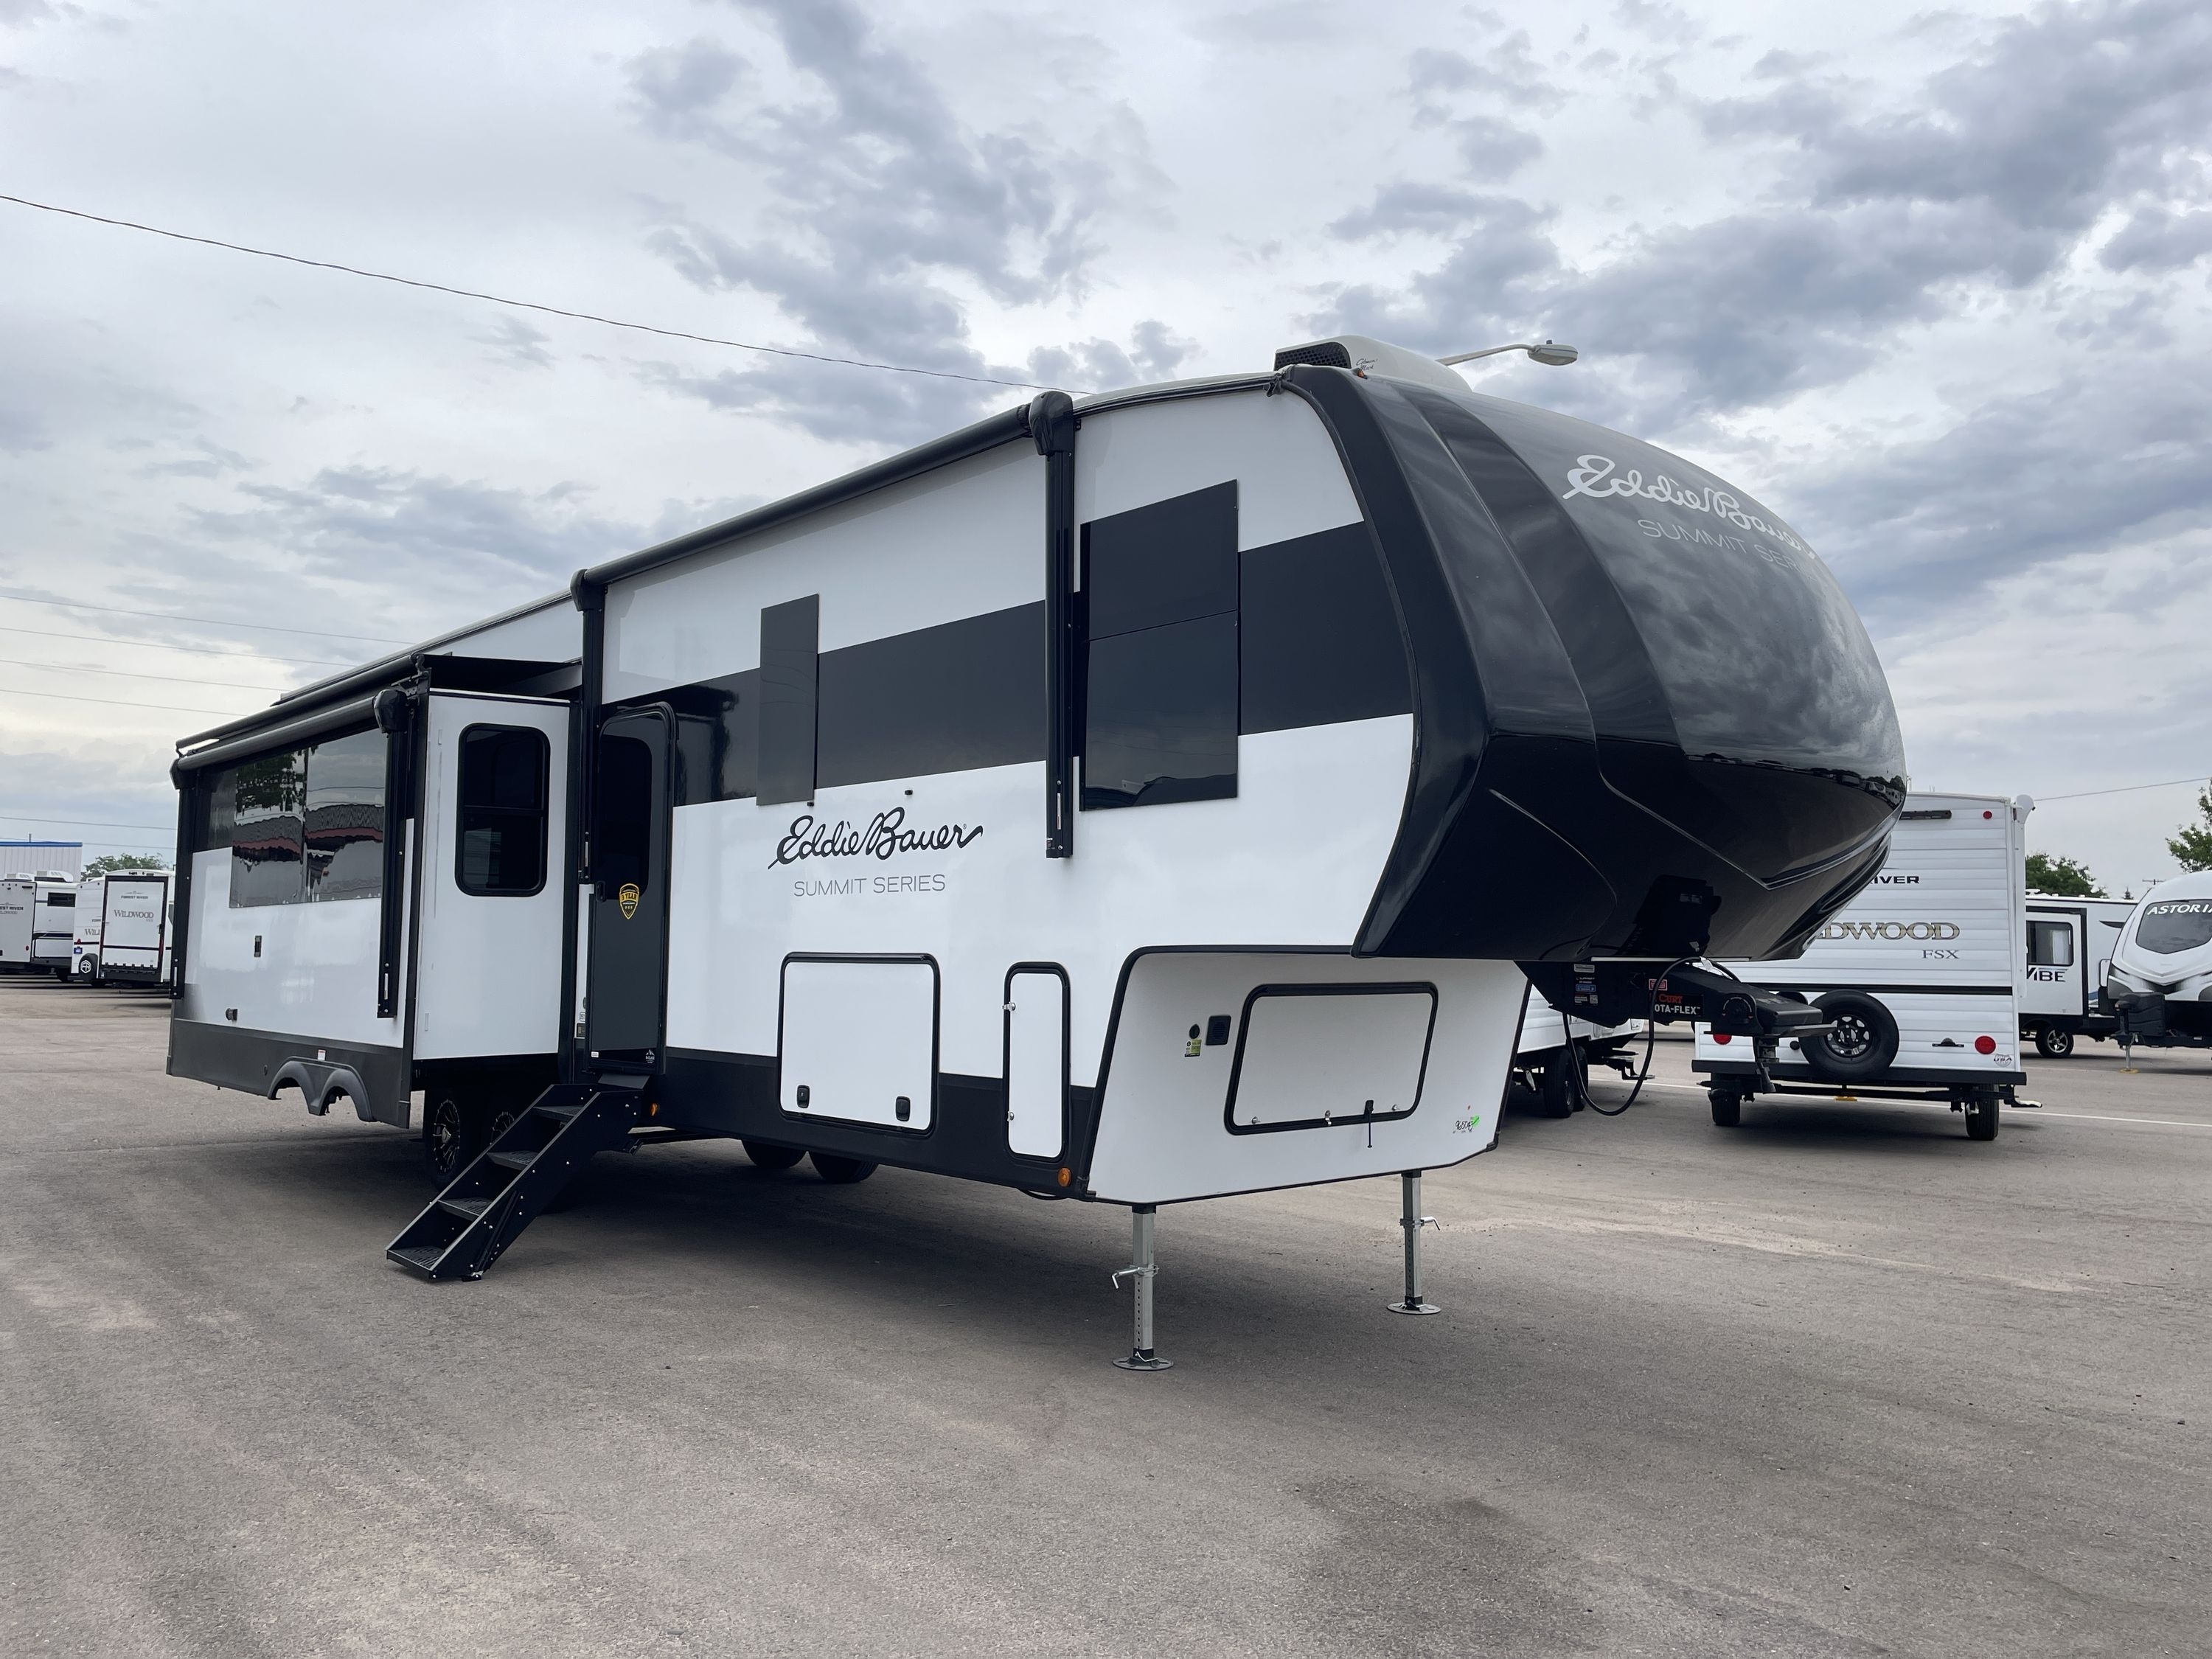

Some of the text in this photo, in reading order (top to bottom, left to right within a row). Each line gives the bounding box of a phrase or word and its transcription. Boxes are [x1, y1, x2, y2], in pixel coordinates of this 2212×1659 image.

[1637, 518, 1747, 554] SUMMIT
[768, 815, 866, 870] Eddie
[793, 874, 946, 897] SUMMIT SERIES
[1869, 875, 1920, 884] IVER
[1922, 949, 1960, 959] FSX
